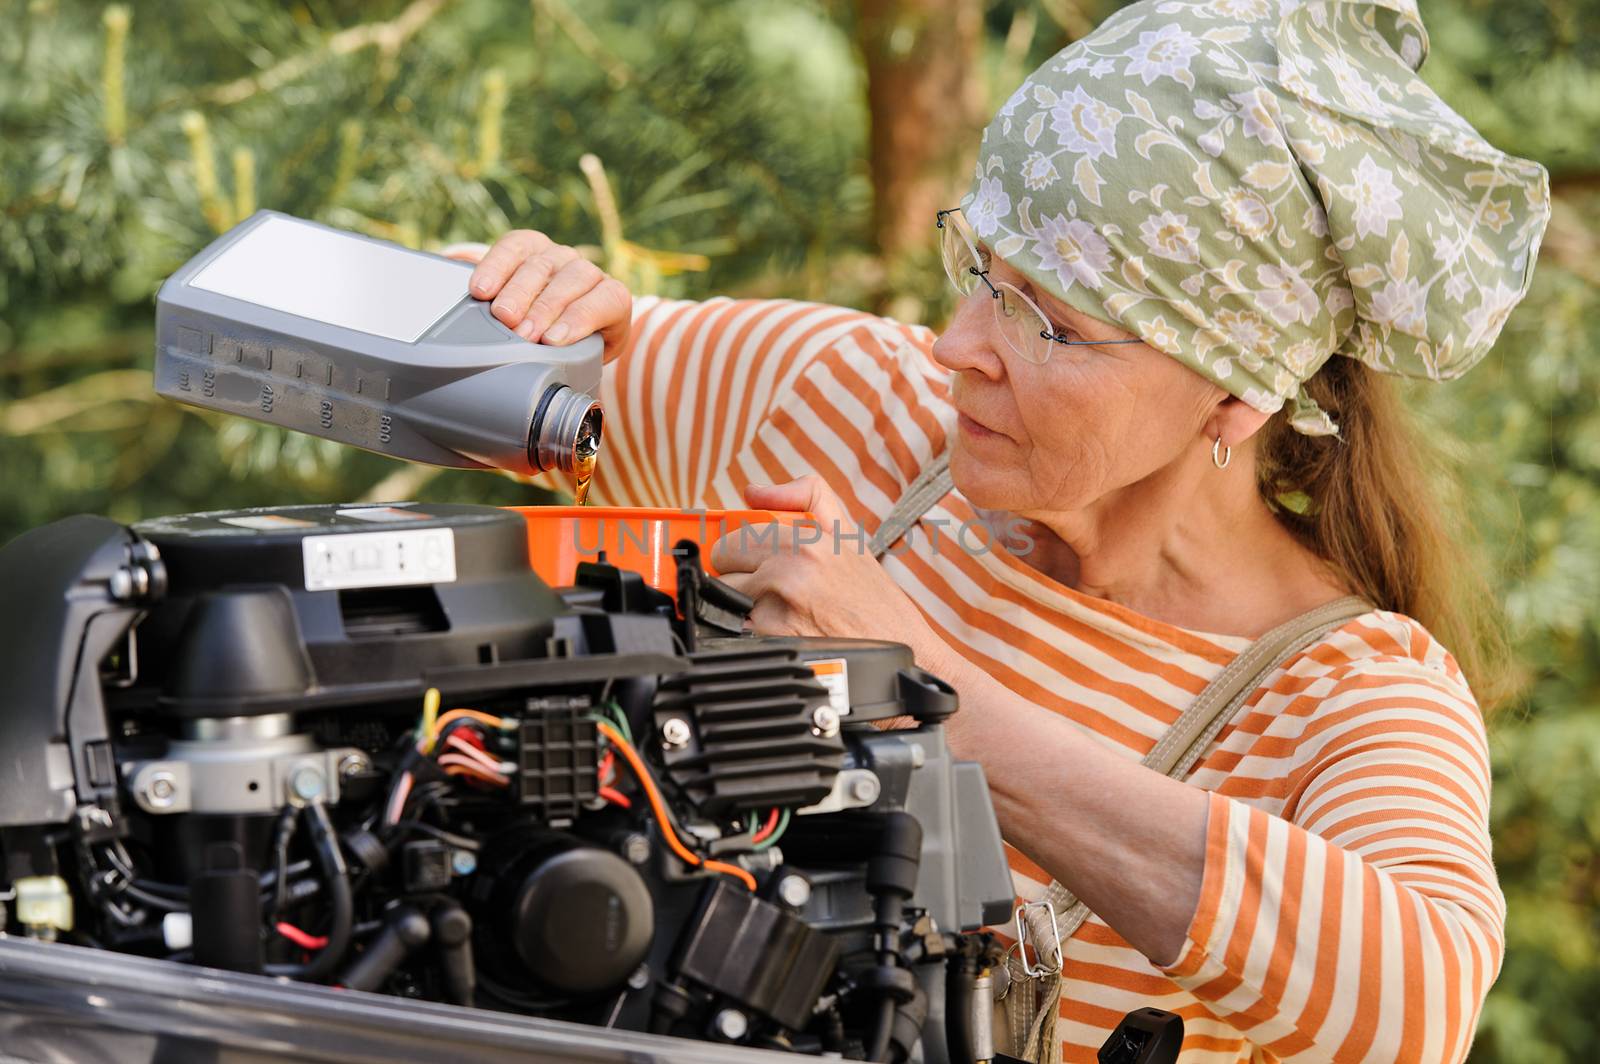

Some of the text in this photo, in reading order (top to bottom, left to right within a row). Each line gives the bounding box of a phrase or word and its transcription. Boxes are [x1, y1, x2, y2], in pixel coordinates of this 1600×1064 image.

[203, 368, 216, 398] 200
[262, 383, 274, 413] 400
[320, 400, 333, 429] 600
[379, 415, 392, 443] 800
